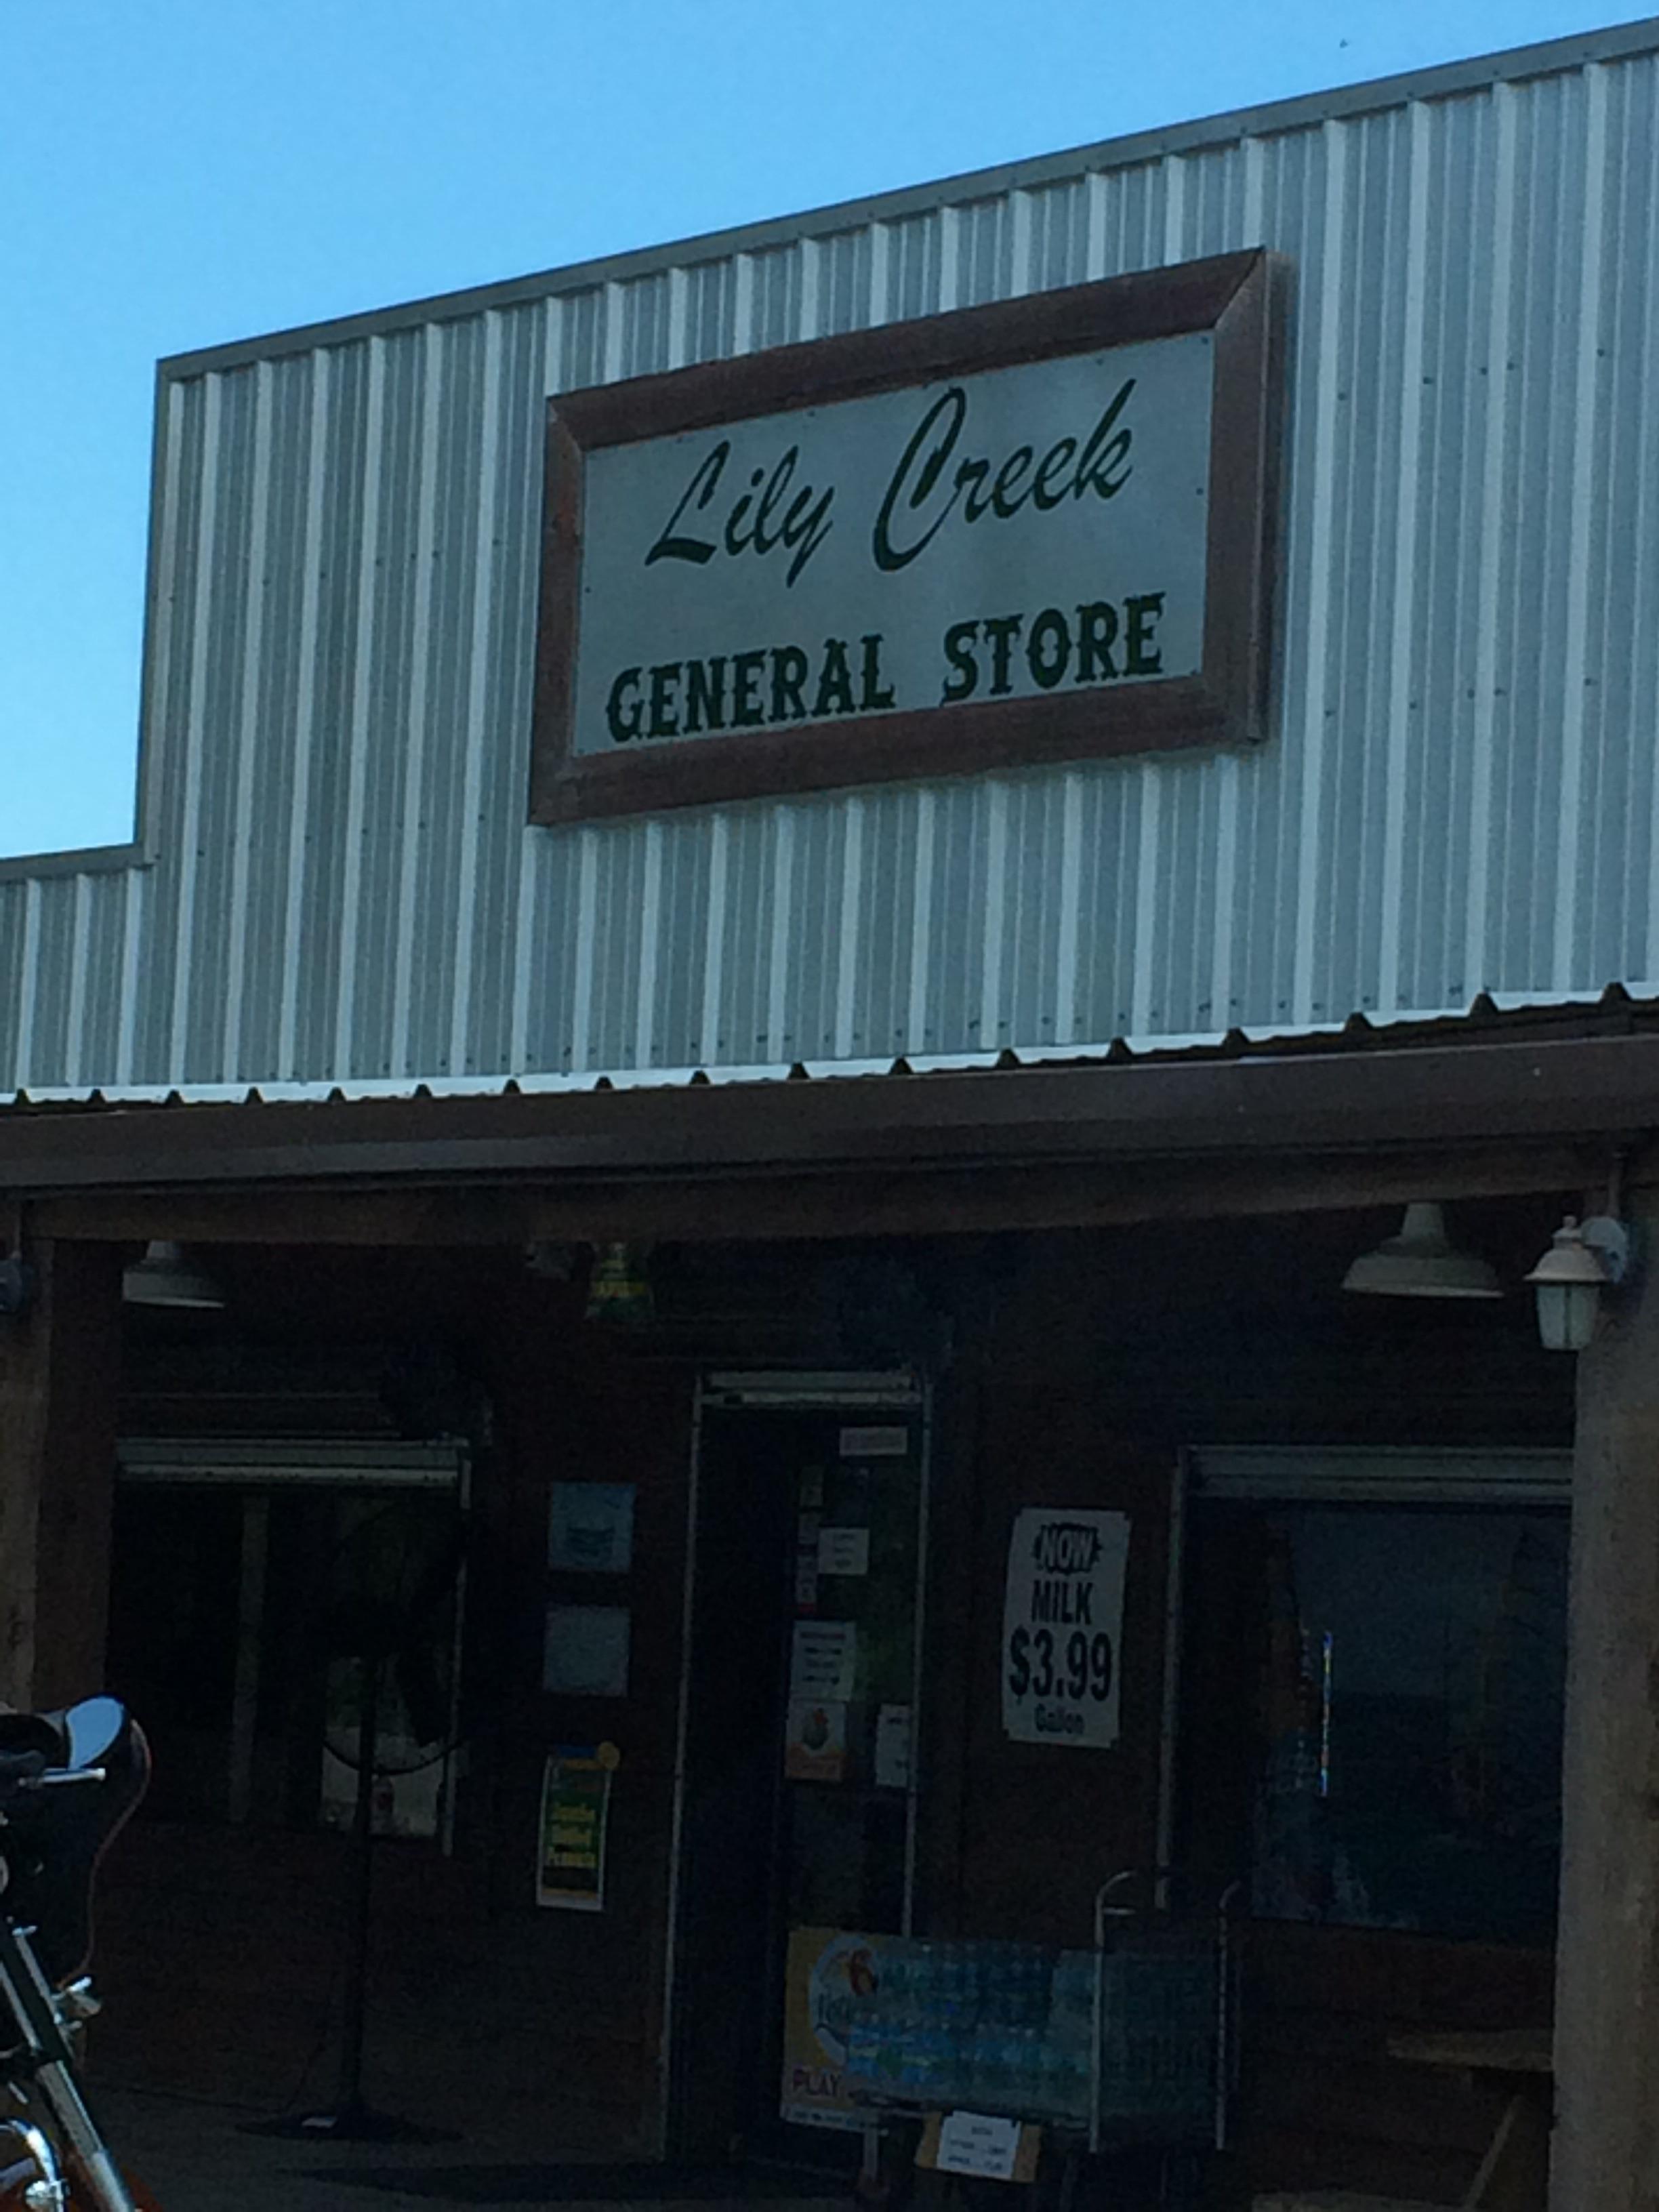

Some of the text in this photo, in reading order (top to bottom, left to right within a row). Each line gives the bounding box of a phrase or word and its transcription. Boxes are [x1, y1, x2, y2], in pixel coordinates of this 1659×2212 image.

[644, 378, 1137, 588] Lily Creek
[605, 592, 1166, 743] GENERAL STORE
[1034, 1523, 1101, 1574] NOW
[1031, 1580, 1092, 1624] MILK
[1010, 1626, 1111, 1701] $3.99
[792, 2067, 841, 2097] PLAY
